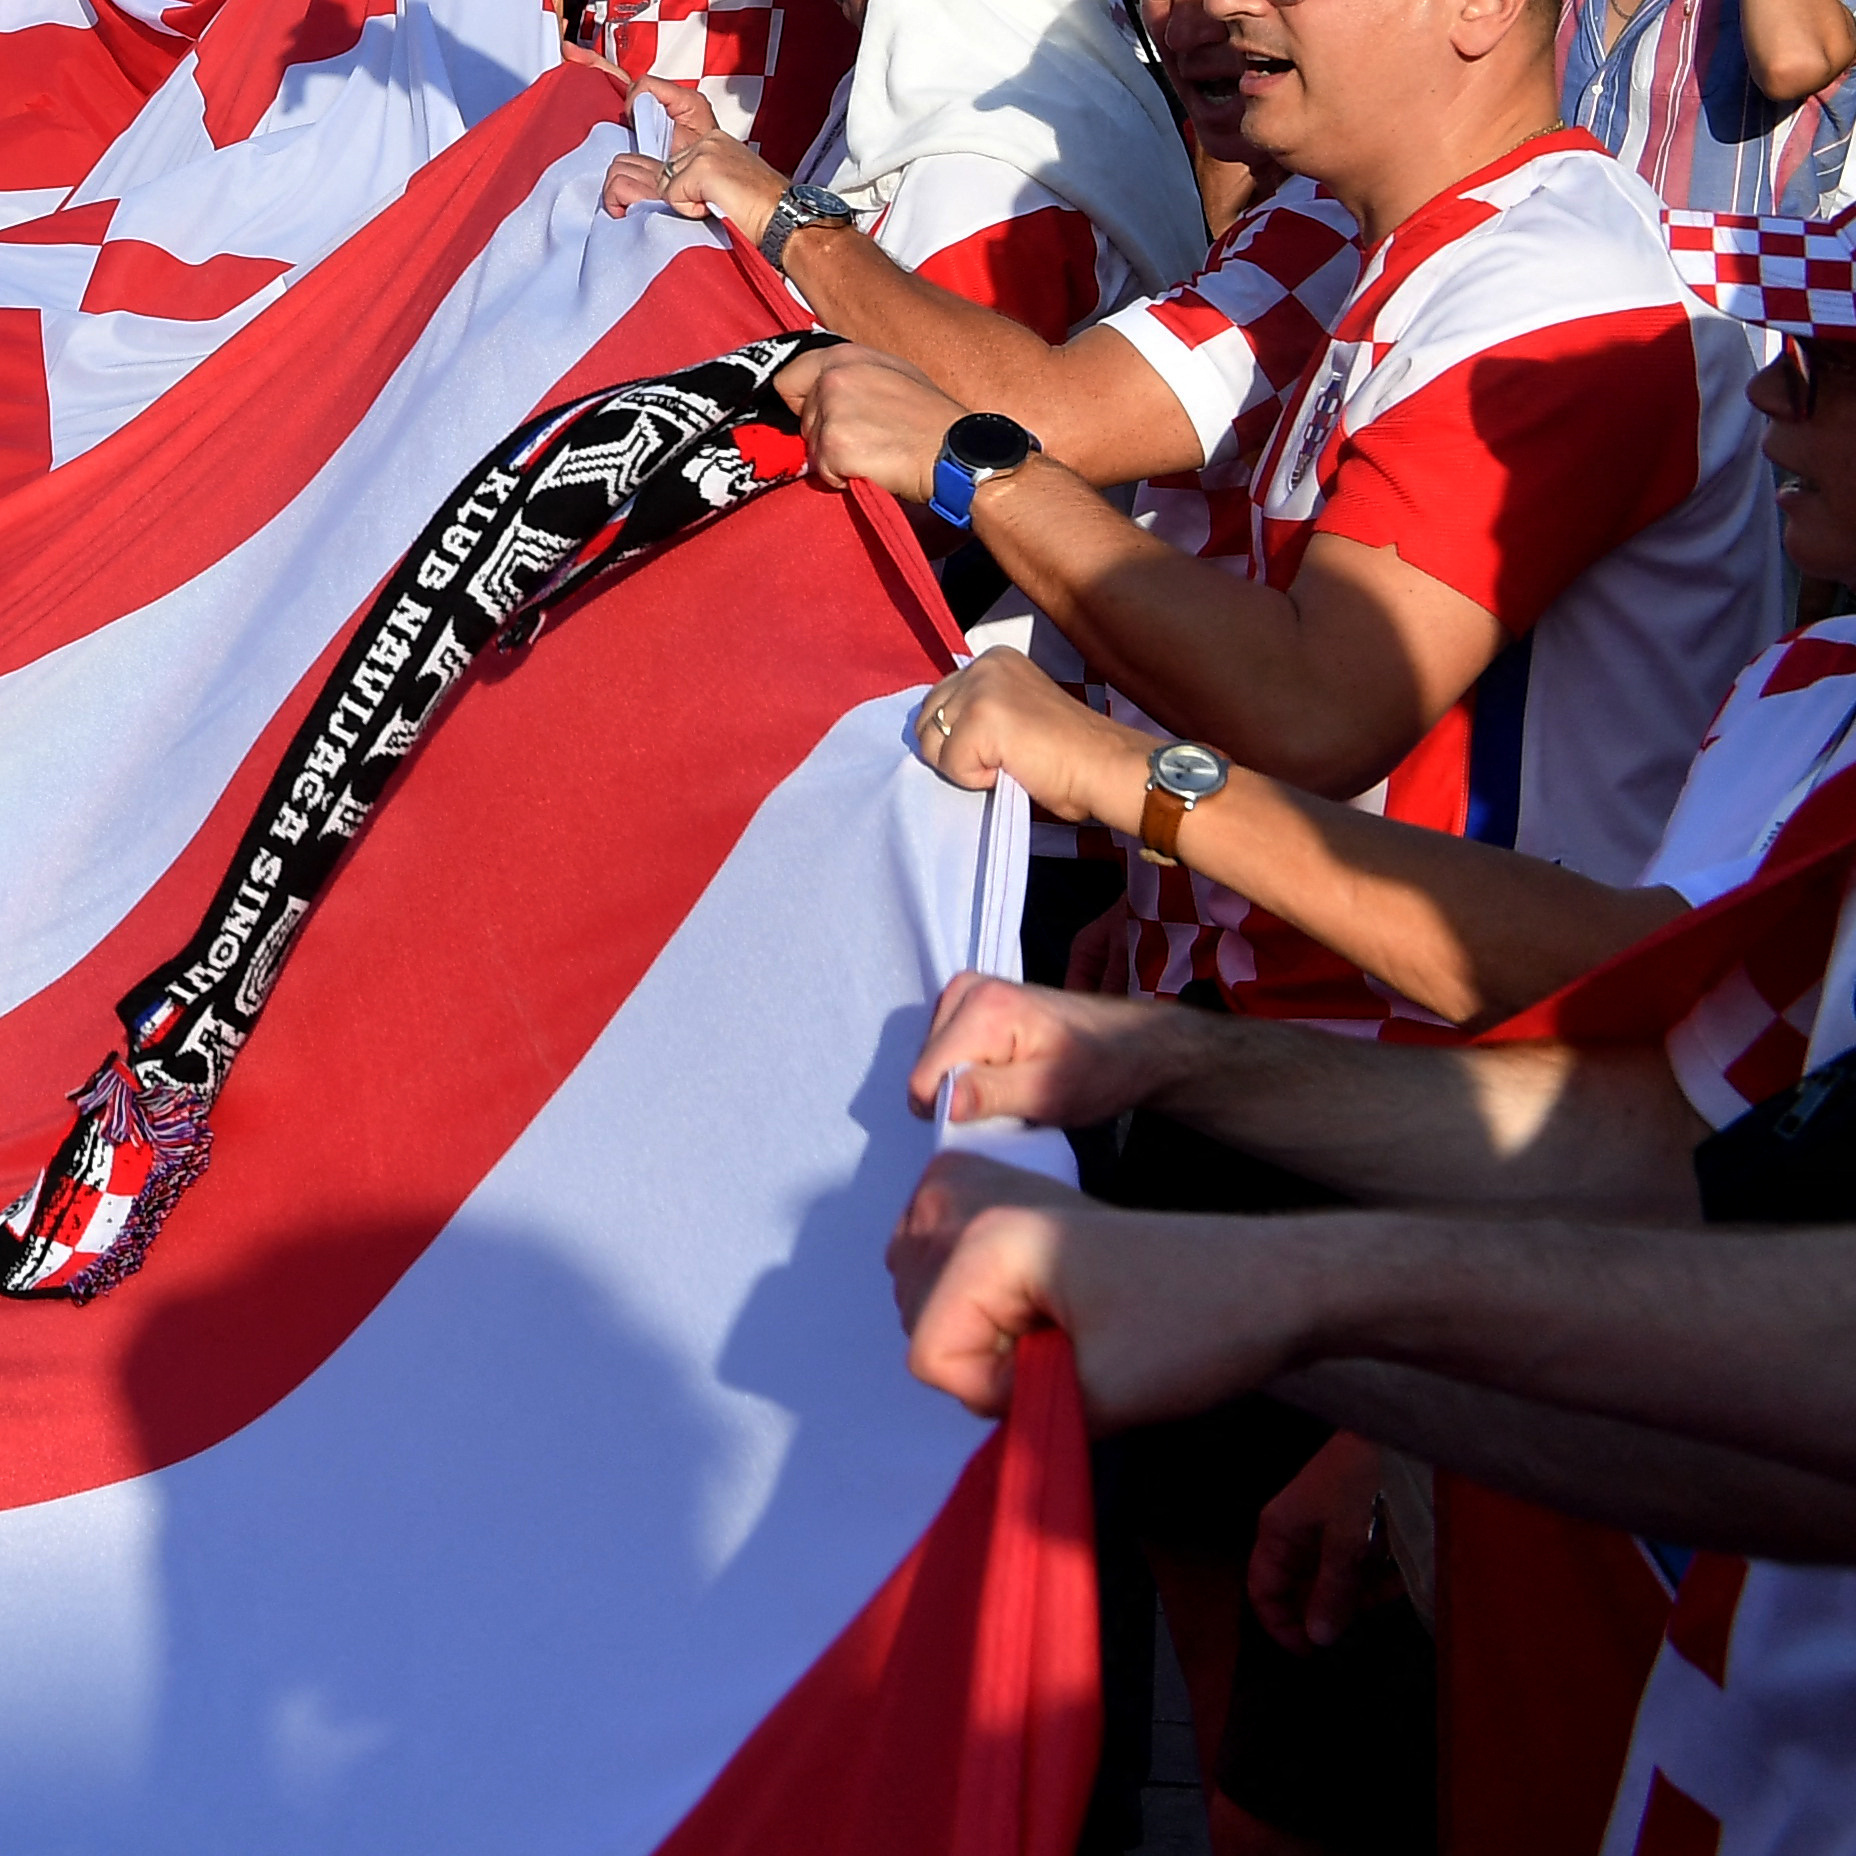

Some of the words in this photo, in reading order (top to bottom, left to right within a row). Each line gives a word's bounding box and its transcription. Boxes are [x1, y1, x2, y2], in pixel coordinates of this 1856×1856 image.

[418, 465, 520, 591] KLUB
[268, 591, 432, 845] NAVIJAČA
[163, 846, 283, 1006] SINOVI
